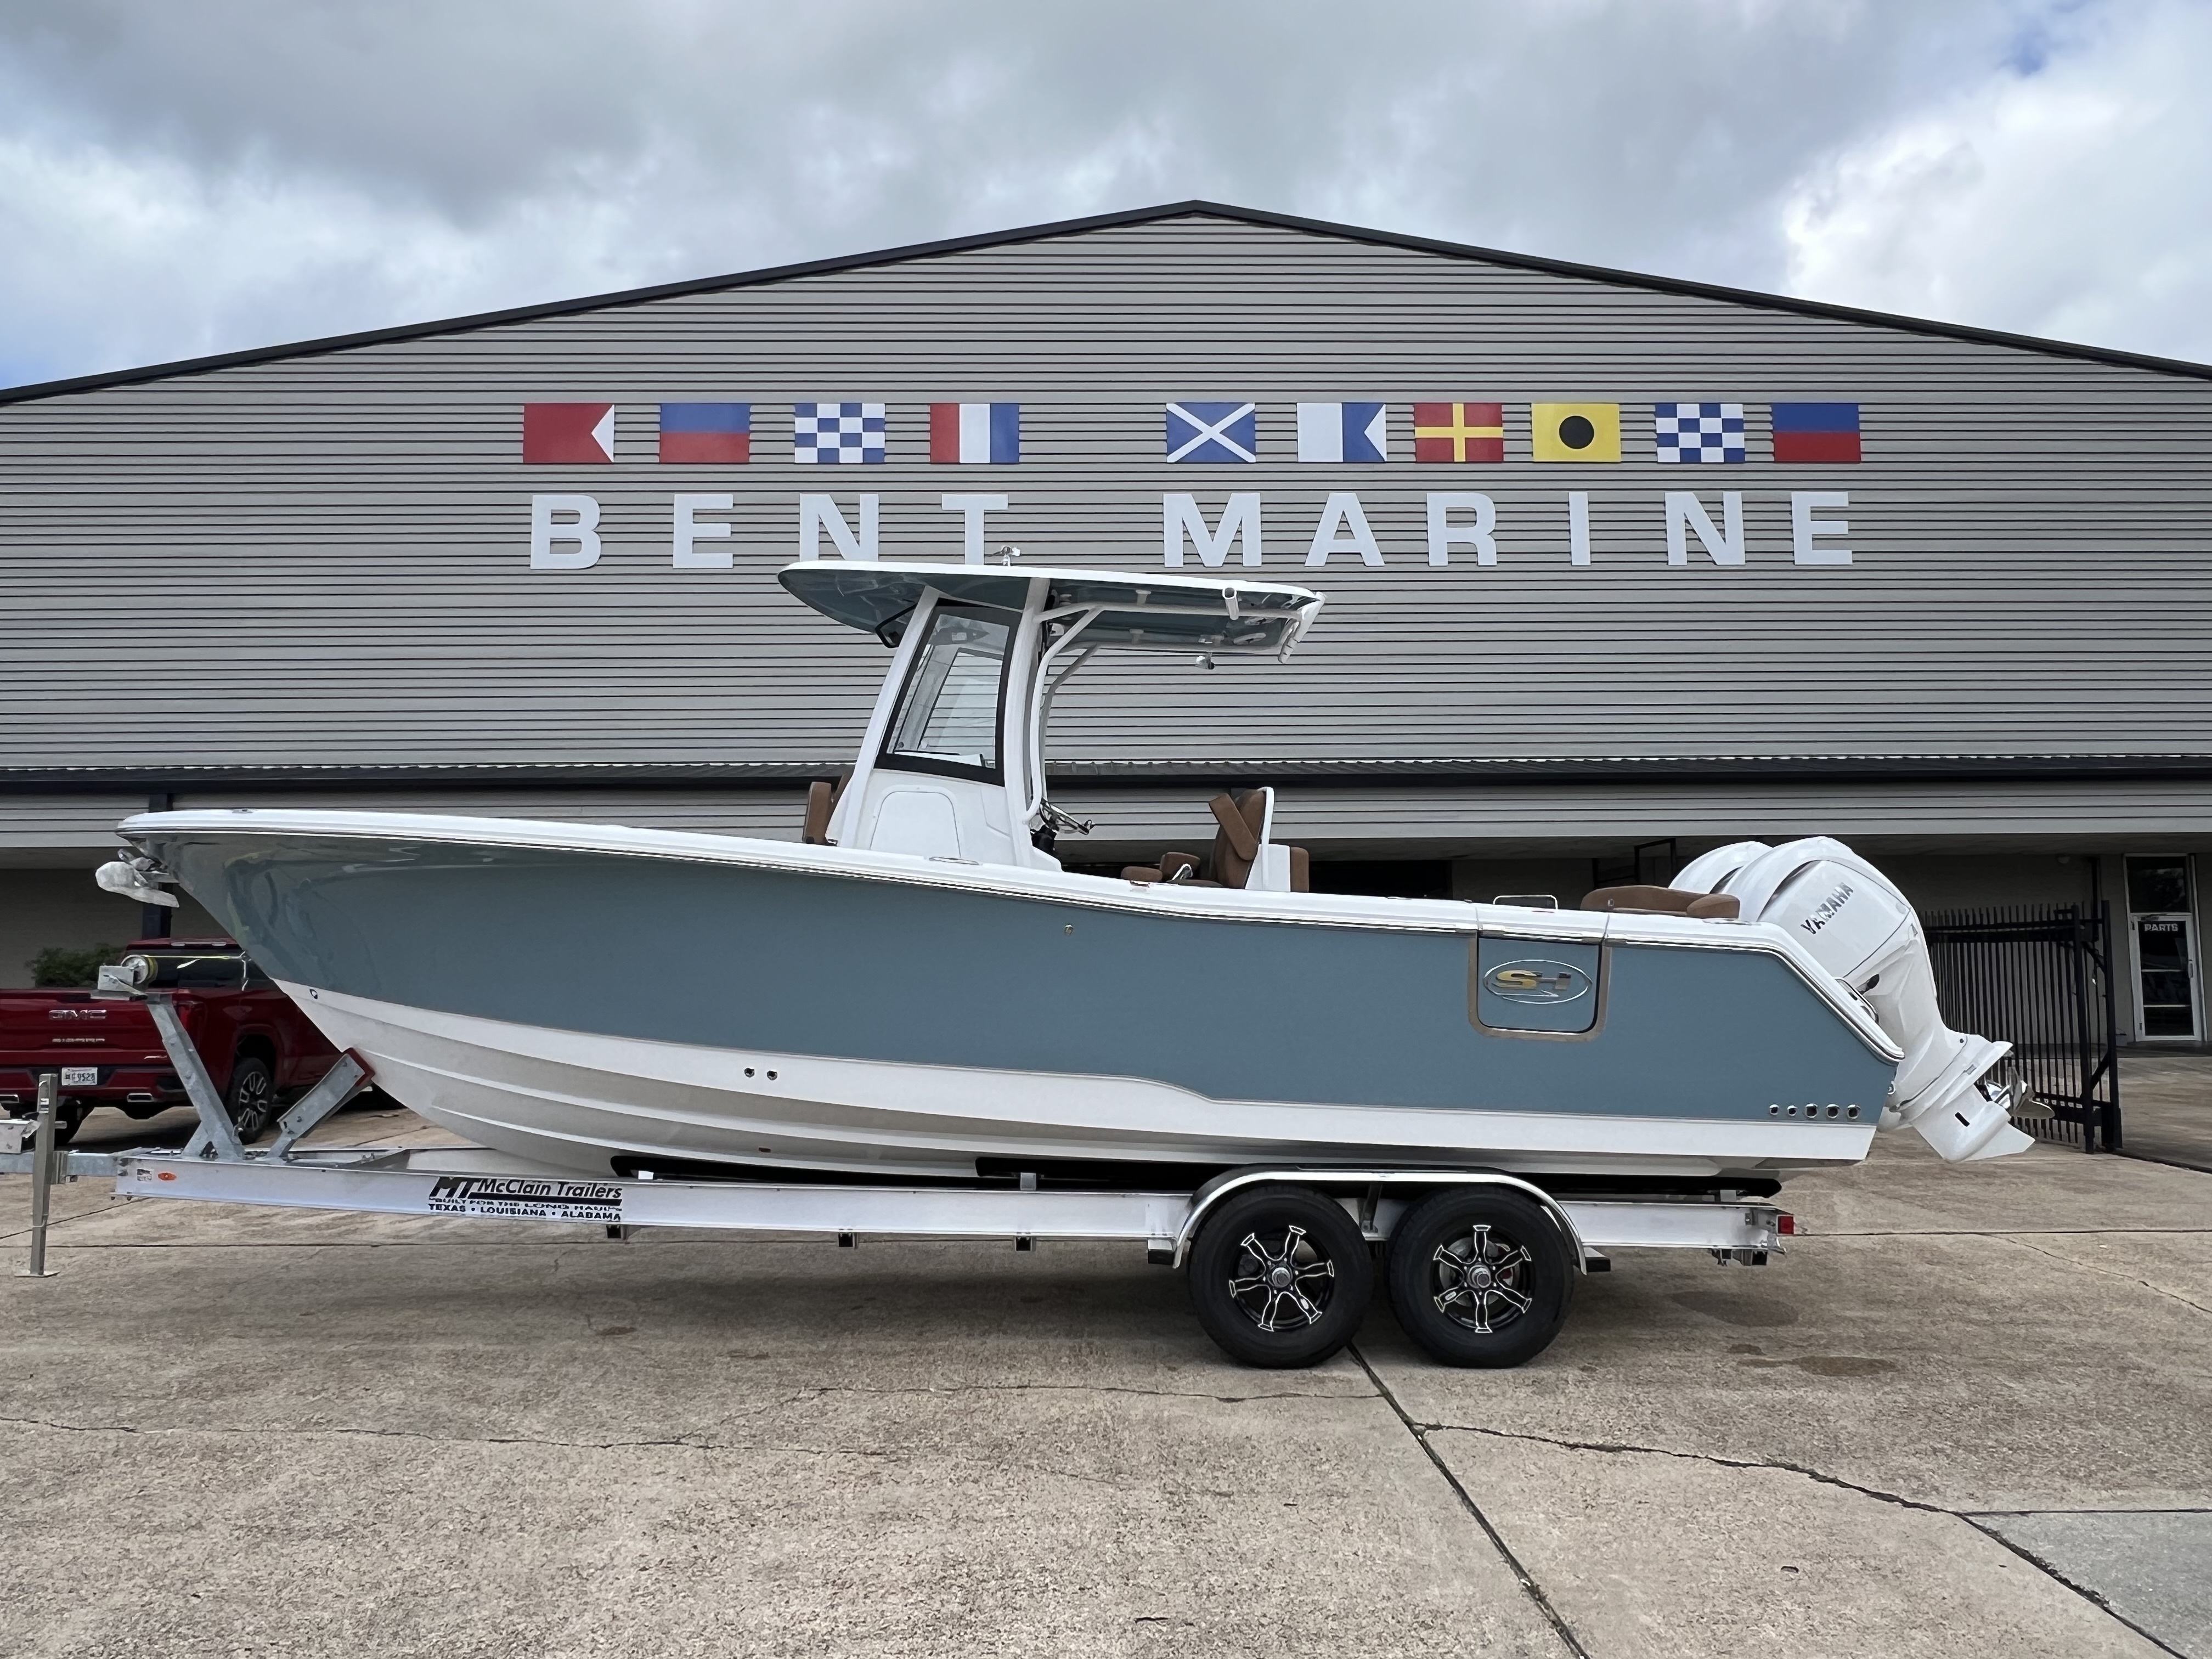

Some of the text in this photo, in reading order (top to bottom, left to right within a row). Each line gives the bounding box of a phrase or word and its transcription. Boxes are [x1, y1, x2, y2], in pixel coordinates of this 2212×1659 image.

[530, 492, 1853, 569] BENT MARINE
[2144, 923, 2179, 932] PARTS
[49, 1009, 107, 1020] GMC
[477, 1178, 623, 1198] McClain Trailers
[428, 1204, 621, 1221] TEXAS LOUISIANA ALABAMA
